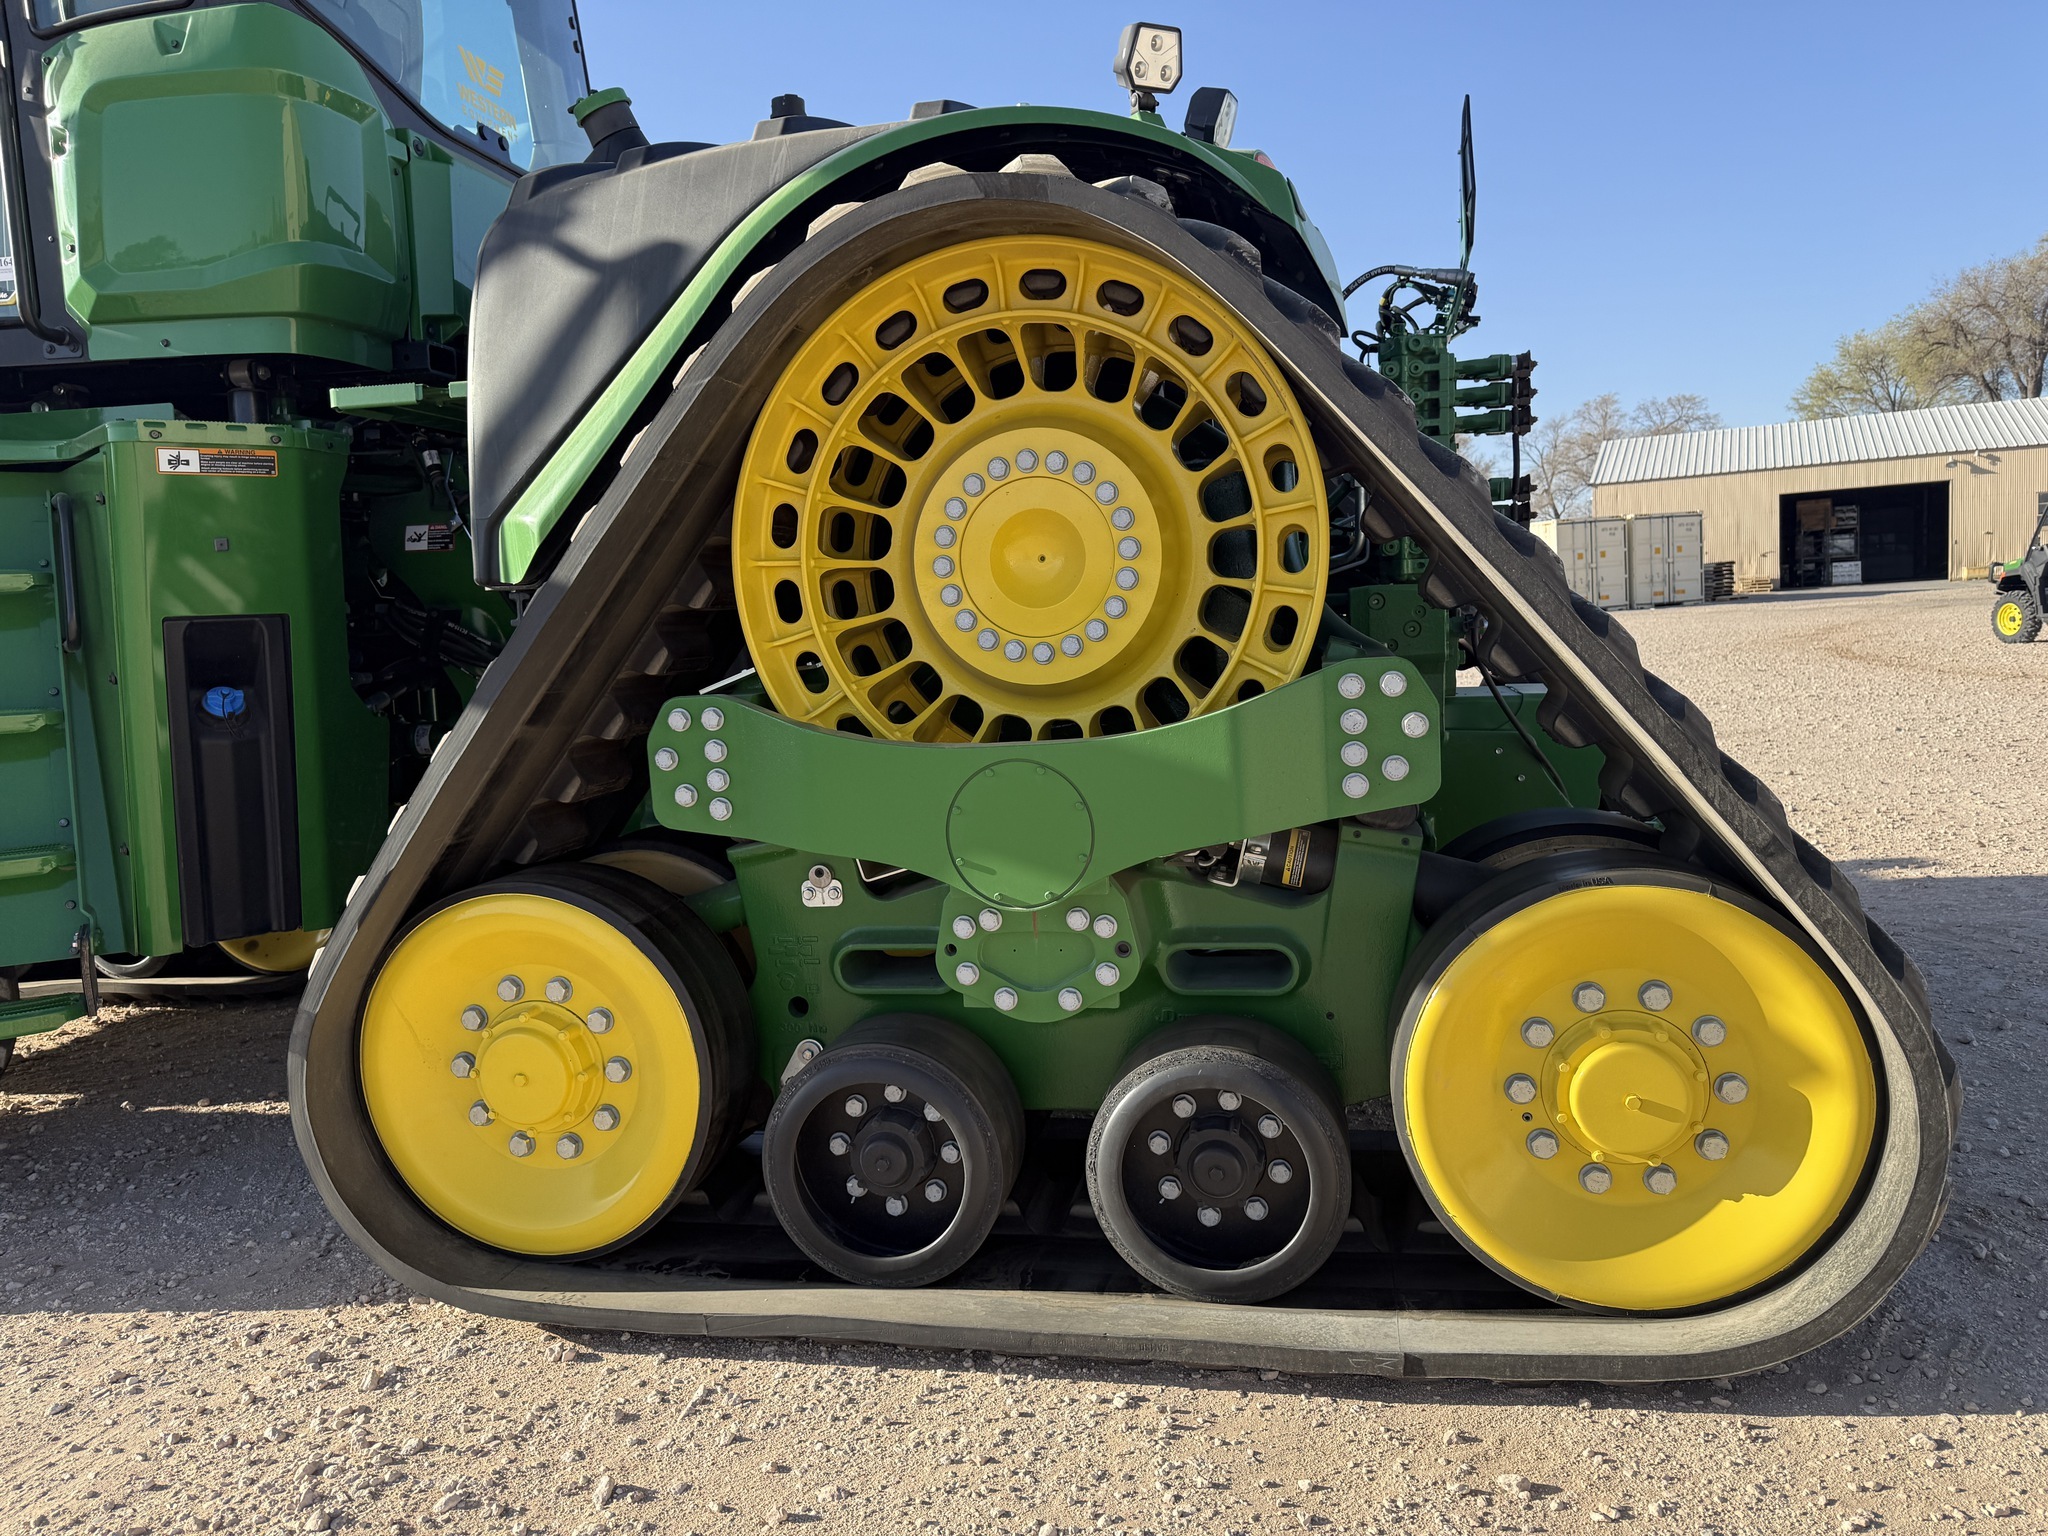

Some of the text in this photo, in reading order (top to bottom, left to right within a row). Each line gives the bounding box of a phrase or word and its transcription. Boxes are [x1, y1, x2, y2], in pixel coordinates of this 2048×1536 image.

[456, 81, 517, 131] WESTERN
[1286, 845, 1295, 868] CAUTION
[1590, 876, 1614, 886] USA
